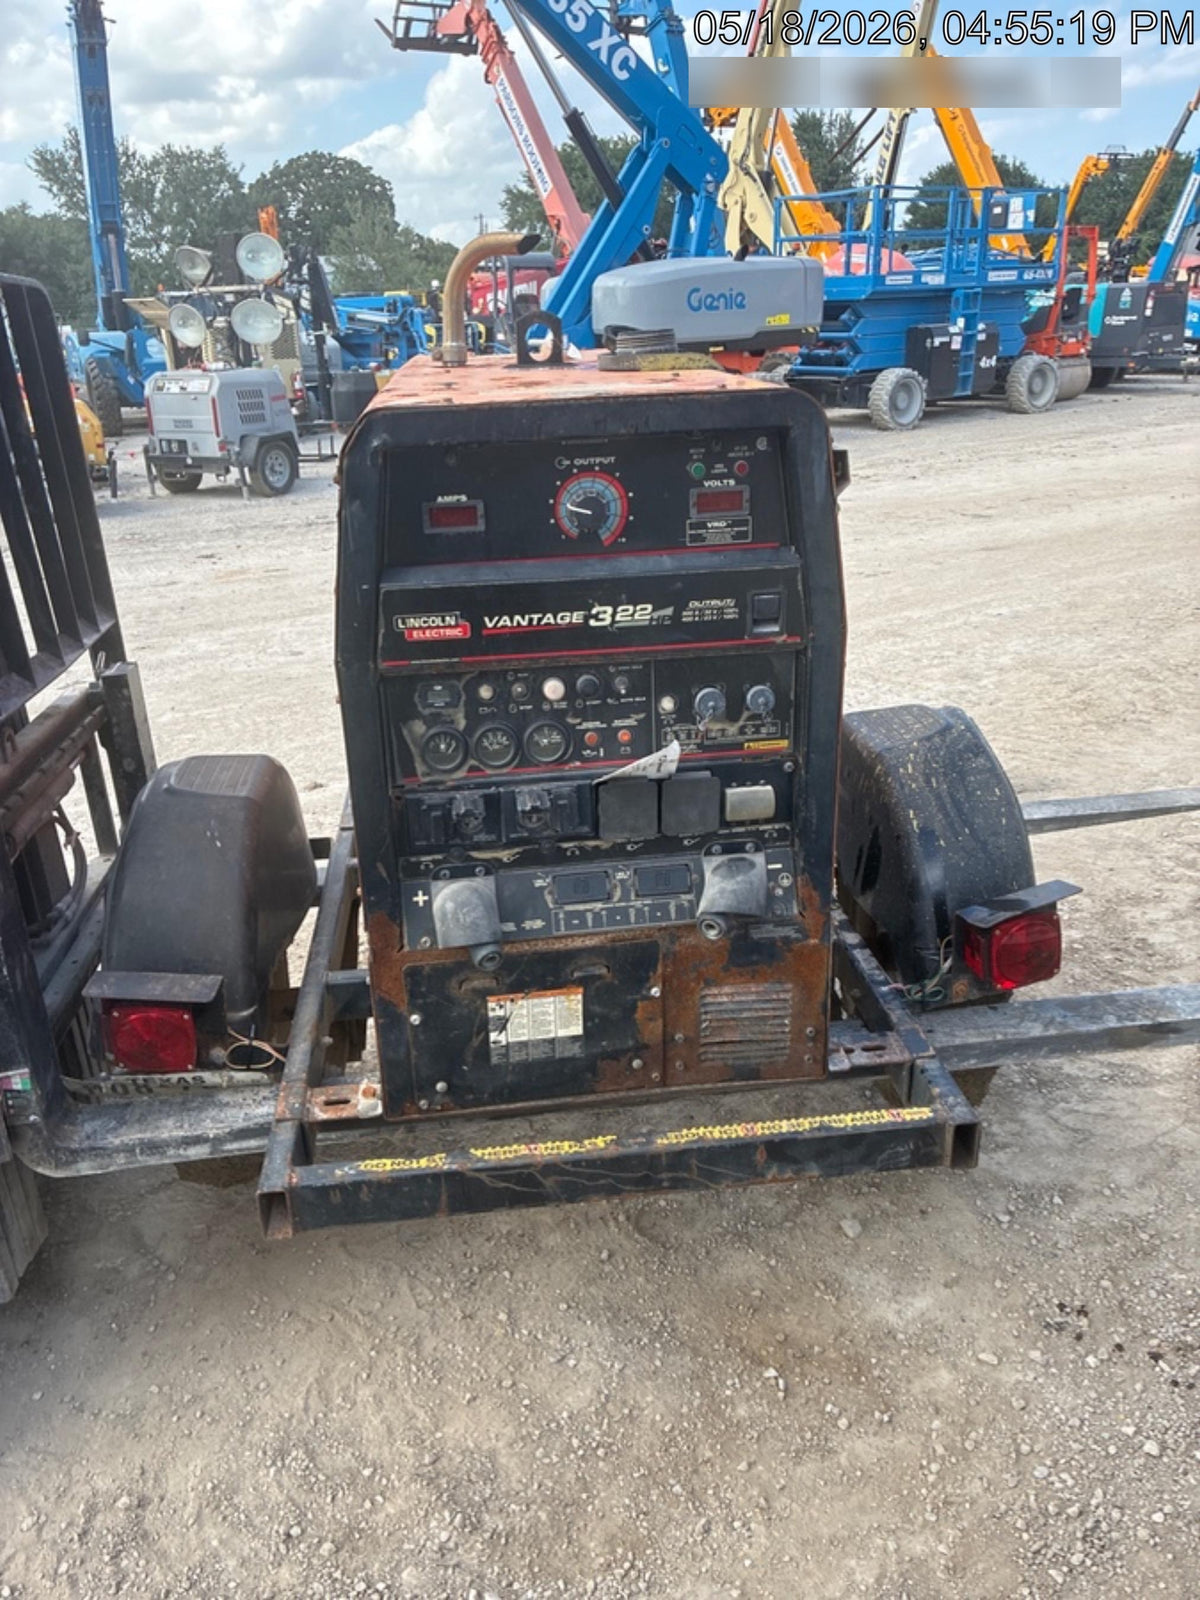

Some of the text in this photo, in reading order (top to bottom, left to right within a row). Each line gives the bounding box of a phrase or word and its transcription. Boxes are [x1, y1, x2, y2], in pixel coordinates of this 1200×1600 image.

[587, 22, 637, 81] XC
[686, 286, 747, 312] Genie
[979, 354, 997, 369] 4x4
[573, 455, 617, 466] OUTPUT
[703, 478, 736, 488] VOLTS
[436, 493, 468, 504] AMPS
[397, 615, 456, 629] LINCOLN
[484, 610, 586, 629] VANTAGE
[588, 603, 654, 627] 322
[412, 627, 464, 639] ELECTRIC
